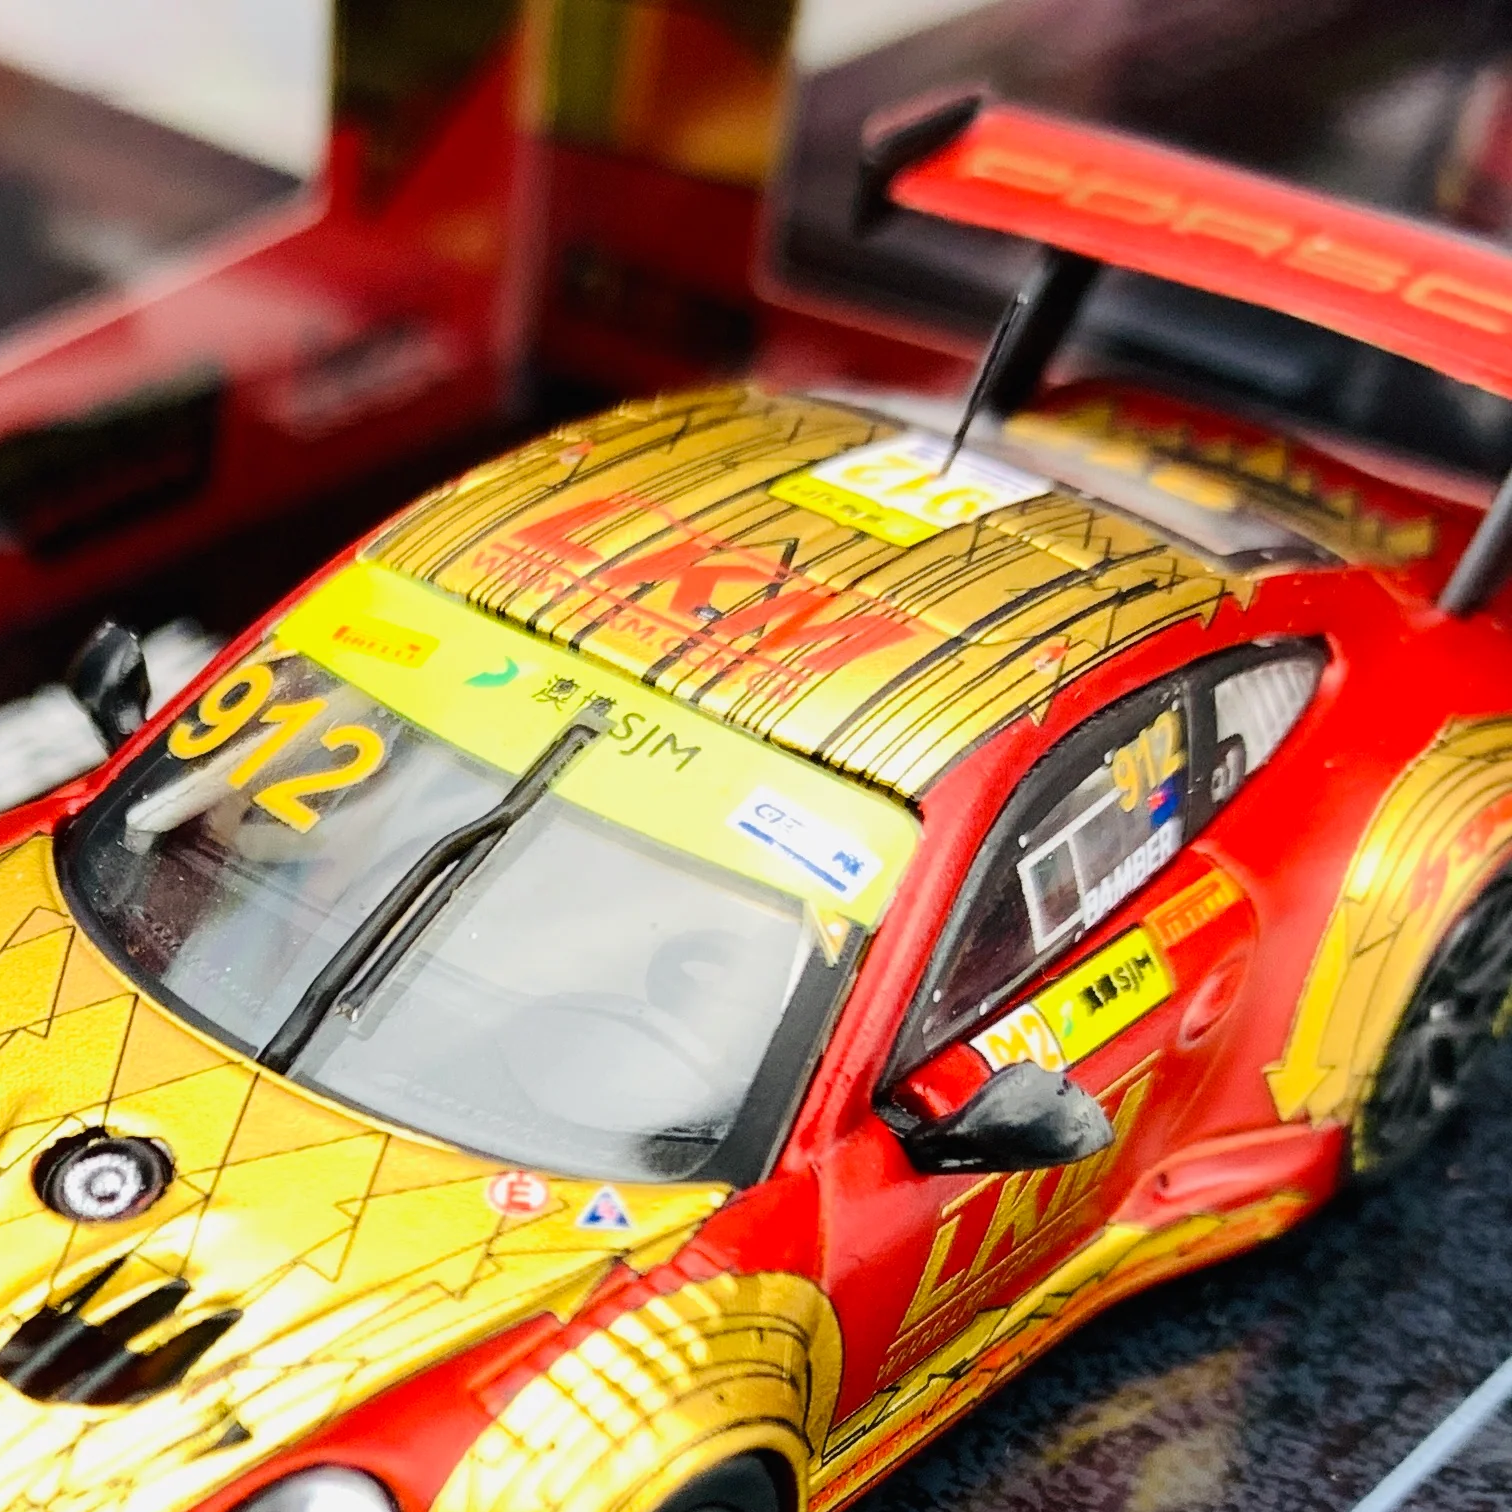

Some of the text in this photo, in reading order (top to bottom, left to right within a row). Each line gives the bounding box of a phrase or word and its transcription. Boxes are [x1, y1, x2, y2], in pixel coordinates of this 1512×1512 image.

[510, 494, 916, 674] LKM
[168, 663, 385, 834] 912
[608, 712, 701, 772] SJM
[1112, 710, 1186, 812] 912
[1083, 818, 1185, 930] BAMBER
